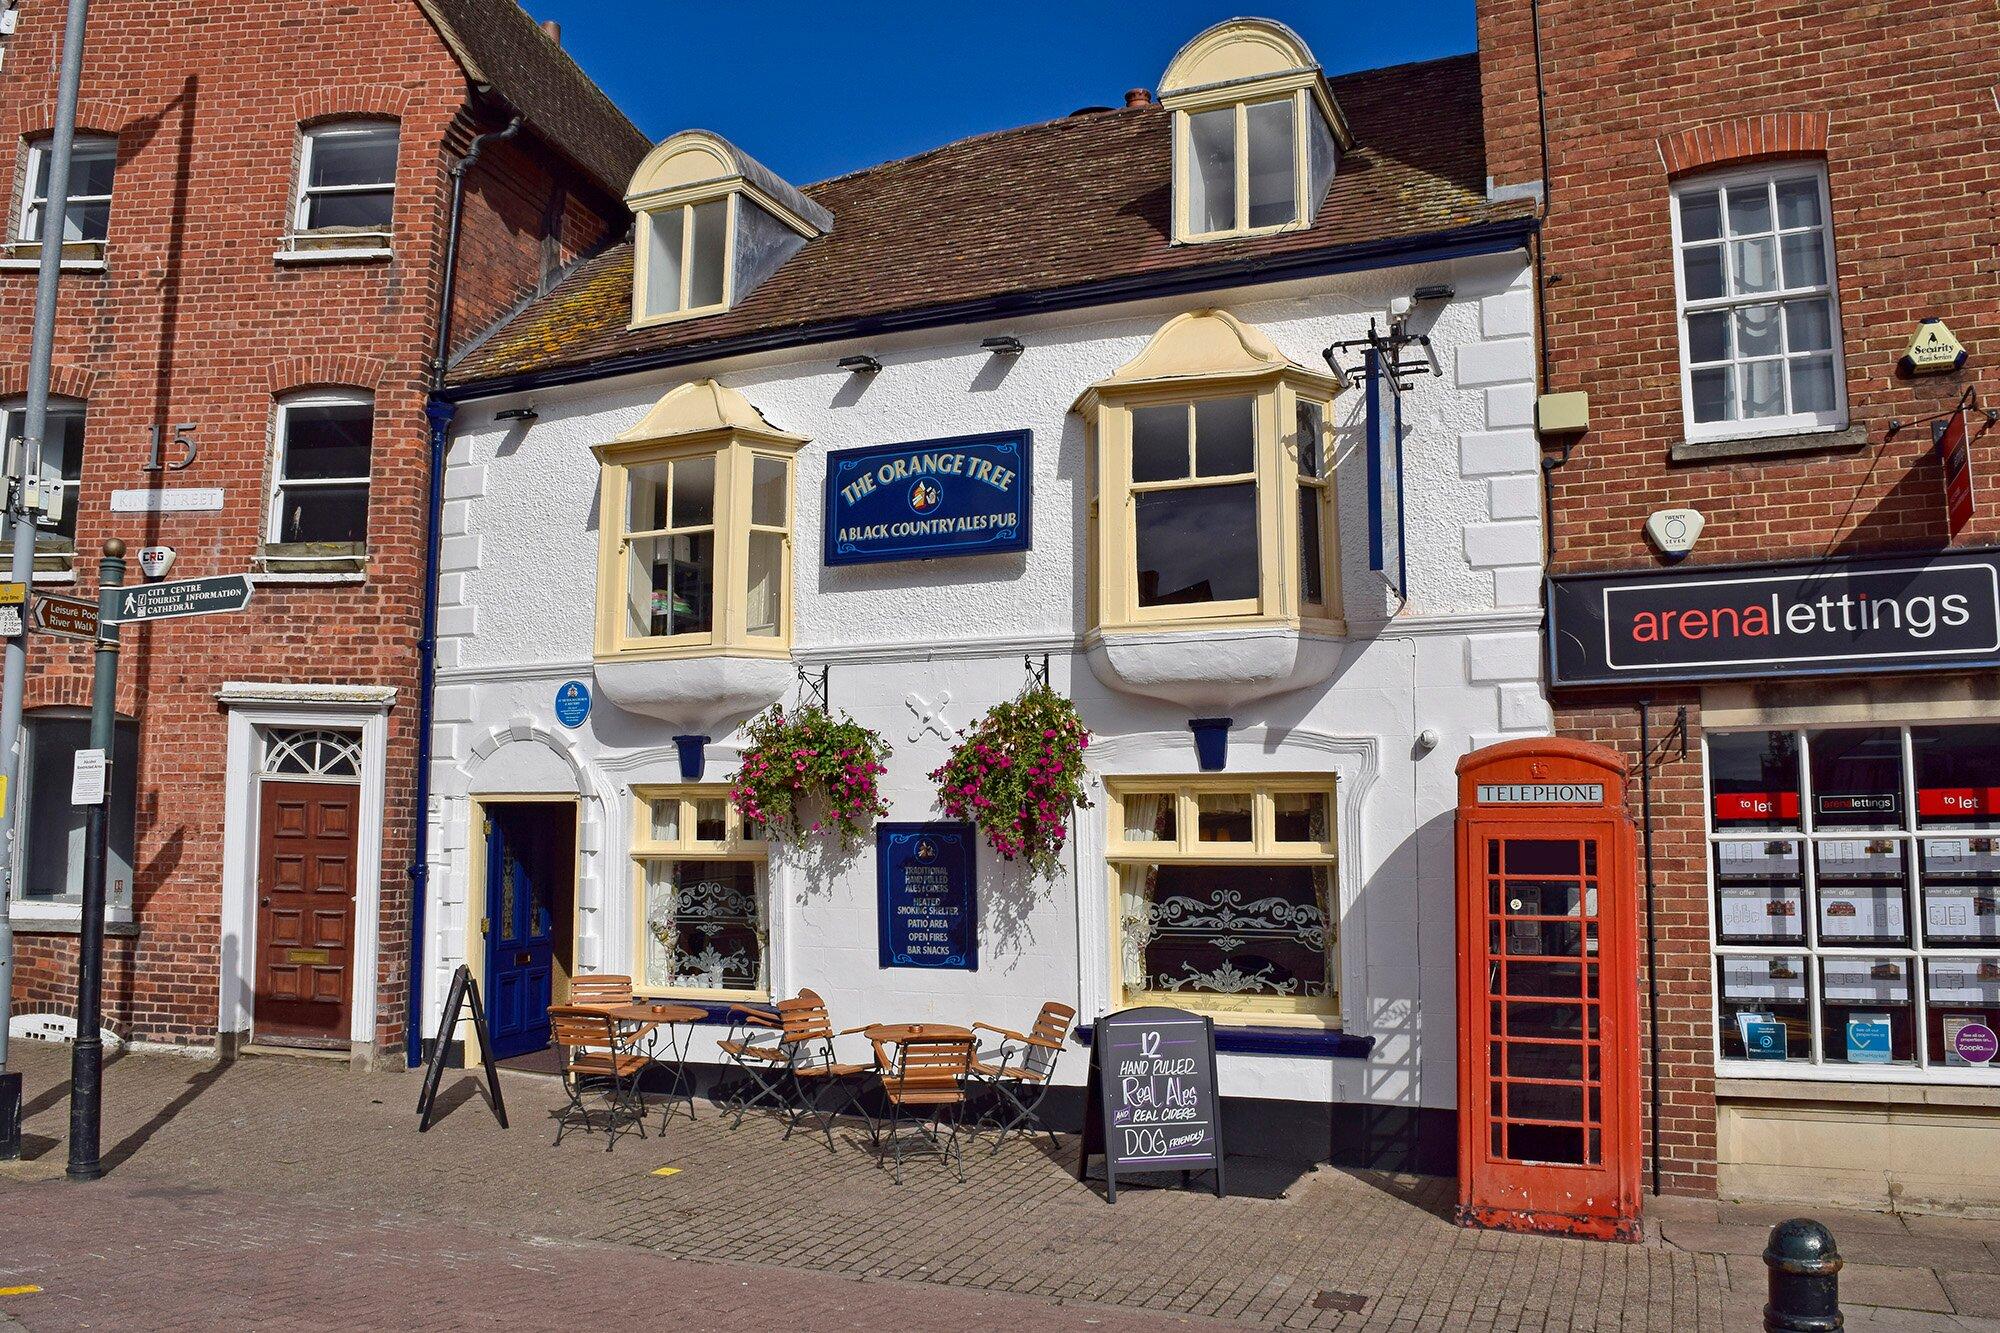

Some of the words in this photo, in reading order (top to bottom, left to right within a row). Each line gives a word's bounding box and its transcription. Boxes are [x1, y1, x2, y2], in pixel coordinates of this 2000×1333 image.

[1914, 343, 1954, 354] Security
[143, 422, 197, 470] 15
[840, 472, 877, 507] THE
[877, 453, 965, 485] ORANGE
[965, 456, 1016, 492] TREE
[119, 494, 156, 507] KING
[163, 493, 217, 506] STREET
[838, 528, 849, 542] A
[849, 524, 889, 540] BLACK
[890, 518, 957, 536] COUNTRY
[957, 515, 987, 530] ALES
[989, 512, 1017, 529] PUB
[143, 552, 164, 561] CRG
[147, 588, 166, 597] CITY
[170, 584, 201, 594] CENTRE
[147, 596, 181, 605] TOURIST
[185, 588, 242, 601] INFORMATION
[50, 603, 79, 616] Leisure
[82, 609, 98, 620] Pool
[147, 602, 195, 614] CATHEDRAL
[49, 615, 71, 628] River
[74, 621, 94, 632] Walk
[1632, 593, 1970, 642] arenalettings
[1483, 785, 1599, 801] TELEPHONE
[1740, 800, 1751, 808] to
[1754, 800, 1772, 812] let
[1944, 796, 1955, 804] to
[1959, 796, 1979, 808] let
[905, 866, 948, 875] TRADITIONAL
[905, 875, 922, 884] HAND
[923, 875, 948, 884] PULLED
[905, 884, 921, 893] ALES
[926, 884, 949, 893] CIDERS
[913, 897, 941, 906] HEATED
[897, 906, 927, 915] SMOKING
[929, 906, 959, 915] SHELTER
[908, 919, 929, 928] PATIO
[930, 919, 949, 928] AREA
[908, 932, 928, 941] OPEN
[929, 932, 949, 941] FIRES
[907, 946, 921, 954] BAR
[922, 946, 949, 955] SNACKS
[1140, 1031, 1162, 1058] 12
[1120, 1060, 1149, 1076] HAND
[1152, 1058, 1195, 1075] PULLED
[1122, 1076, 1162, 1107] Real
[1166, 1077, 1198, 1107] Ales
[1115, 1110, 1130, 1121] AND
[1133, 1109, 1158, 1123] REAL
[1161, 1107, 1197, 1121] CIDERS
[1125, 1128, 1167, 1157] DOG
[1169, 1129, 1205, 1149] FRIENDLY
